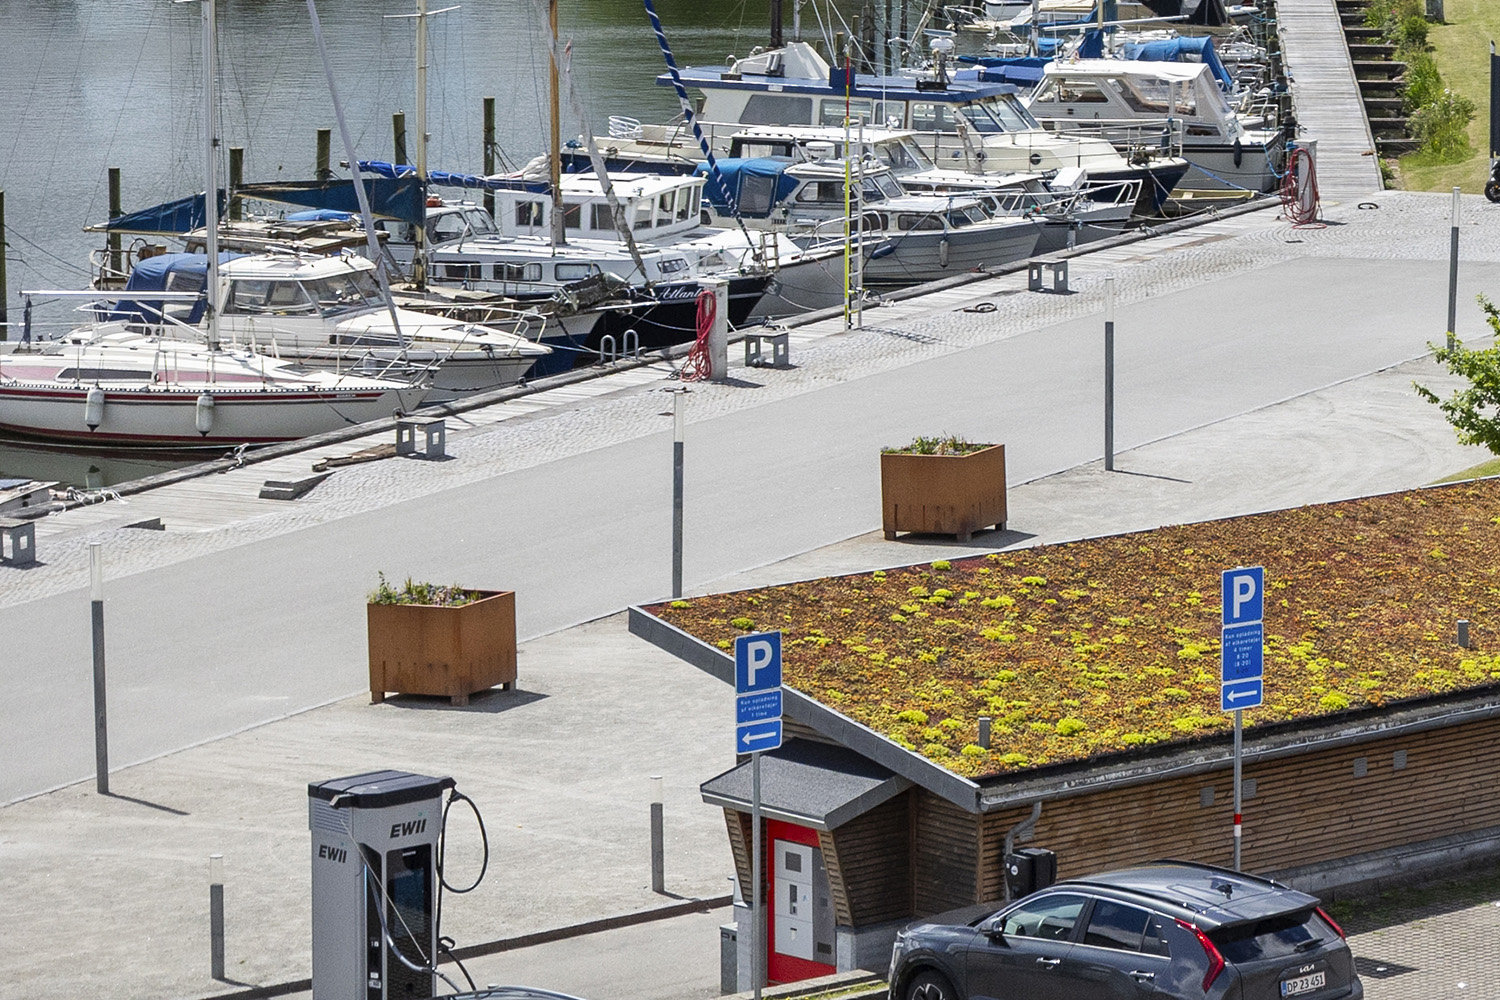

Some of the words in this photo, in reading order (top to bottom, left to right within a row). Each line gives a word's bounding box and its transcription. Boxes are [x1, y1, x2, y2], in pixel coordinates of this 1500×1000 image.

[658, 286, 702, 299] Atlant
[1233, 575, 1256, 619] P
[747, 640, 773, 687] P
[390, 819, 427, 839] EWII
[318, 844, 347, 864] EWII
[1300, 964, 1315, 973] KIA
[1287, 981, 1298, 992] DP
[1300, 978, 1309, 990] 23
[1310, 975, 1324, 986] 451
